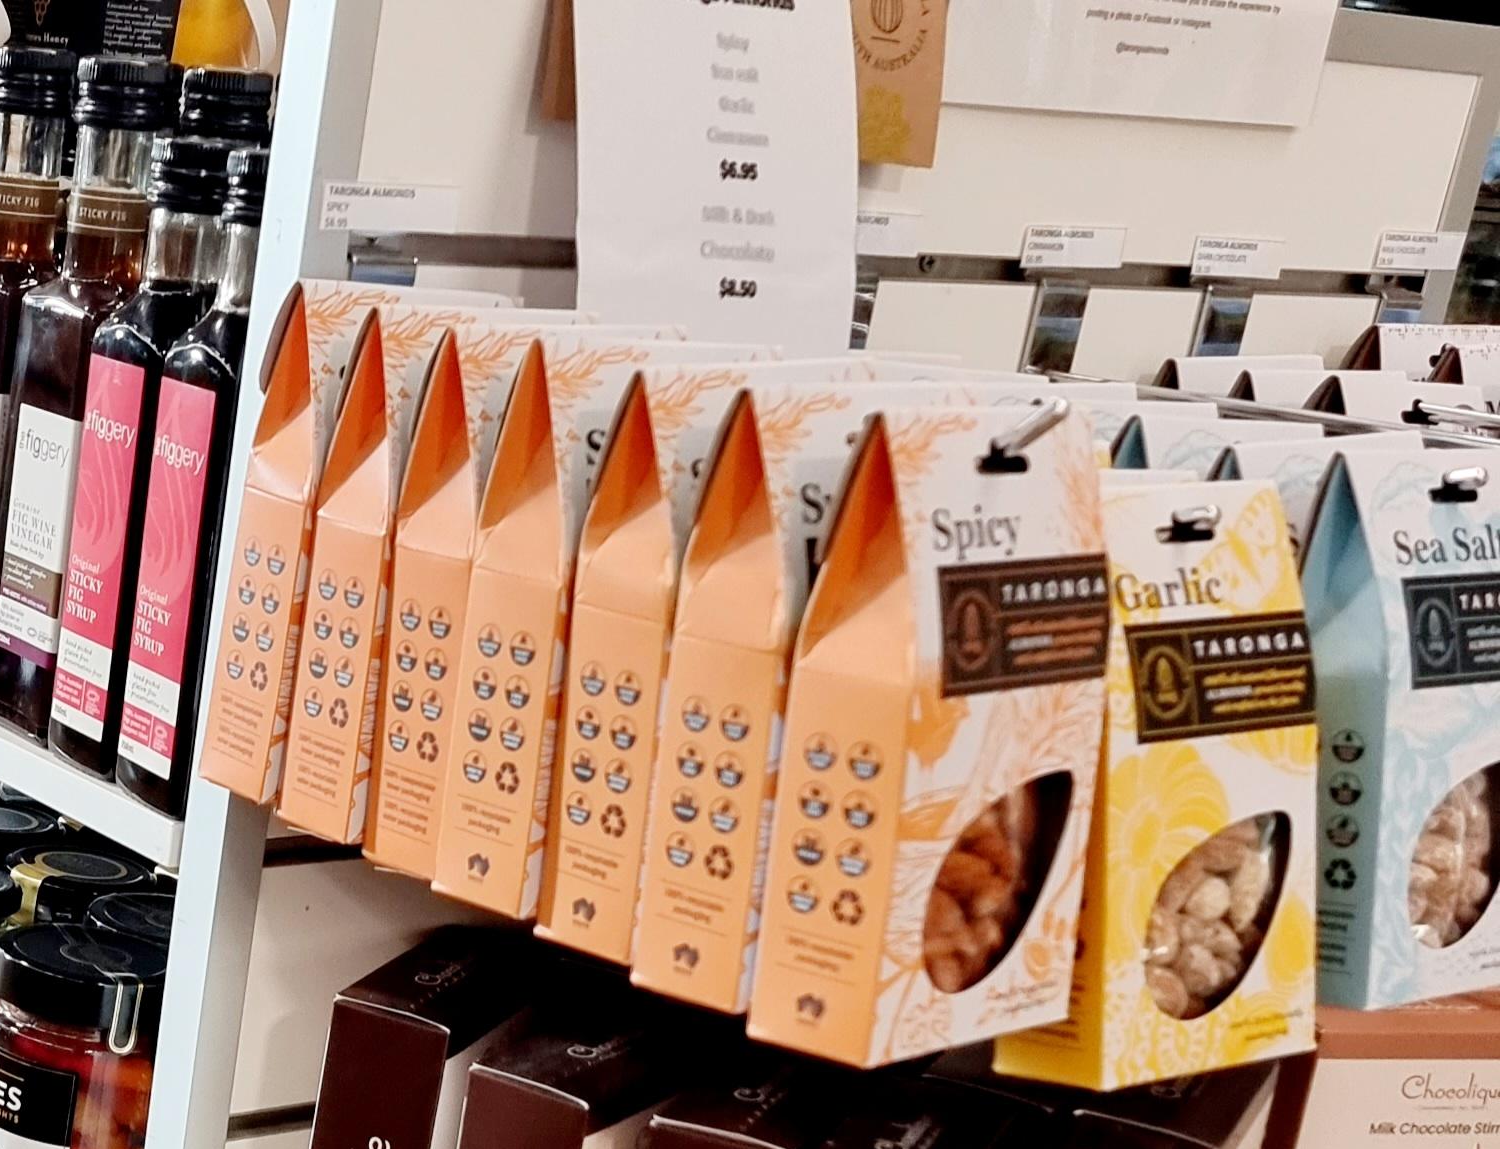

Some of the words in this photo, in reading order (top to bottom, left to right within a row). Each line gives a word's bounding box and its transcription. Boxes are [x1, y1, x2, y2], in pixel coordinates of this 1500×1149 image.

[44, 32, 69, 47] Honey
[720, 159, 758, 181] $6.95
[24, 196, 40, 209] FIG
[78, 208, 109, 221] STICKY
[111, 209, 128, 222] FIG
[719, 277, 757, 299] $8.50
[91, 409, 136, 449] figgery
[25, 428, 69, 468] figgery
[160, 432, 205, 476] figgery
[12, 507, 28, 526] FIG
[31, 514, 57, 538] WINE
[931, 503, 1020, 561] Spicy
[10, 522, 53, 551] VINEGAR
[1392, 528, 1448, 566] Sea
[72, 553, 100, 575] Original
[68, 584, 84, 603] FIG
[69, 570, 104, 595] STICKY
[139, 583, 168, 604] Original
[1001, 575, 1106, 603] TARONGA
[1114, 565, 1222, 612] Garlic
[65, 601, 97, 625] SYRUP
[136, 615, 152, 634] FIG
[137, 600, 172, 627] STICKY
[134, 632, 165, 657] SYRUP
[1192, 631, 1306, 658] TARONGA
[1369, 1122, 1396, 1135] Milk
[1399, 1121, 1472, 1135] Chocolate
